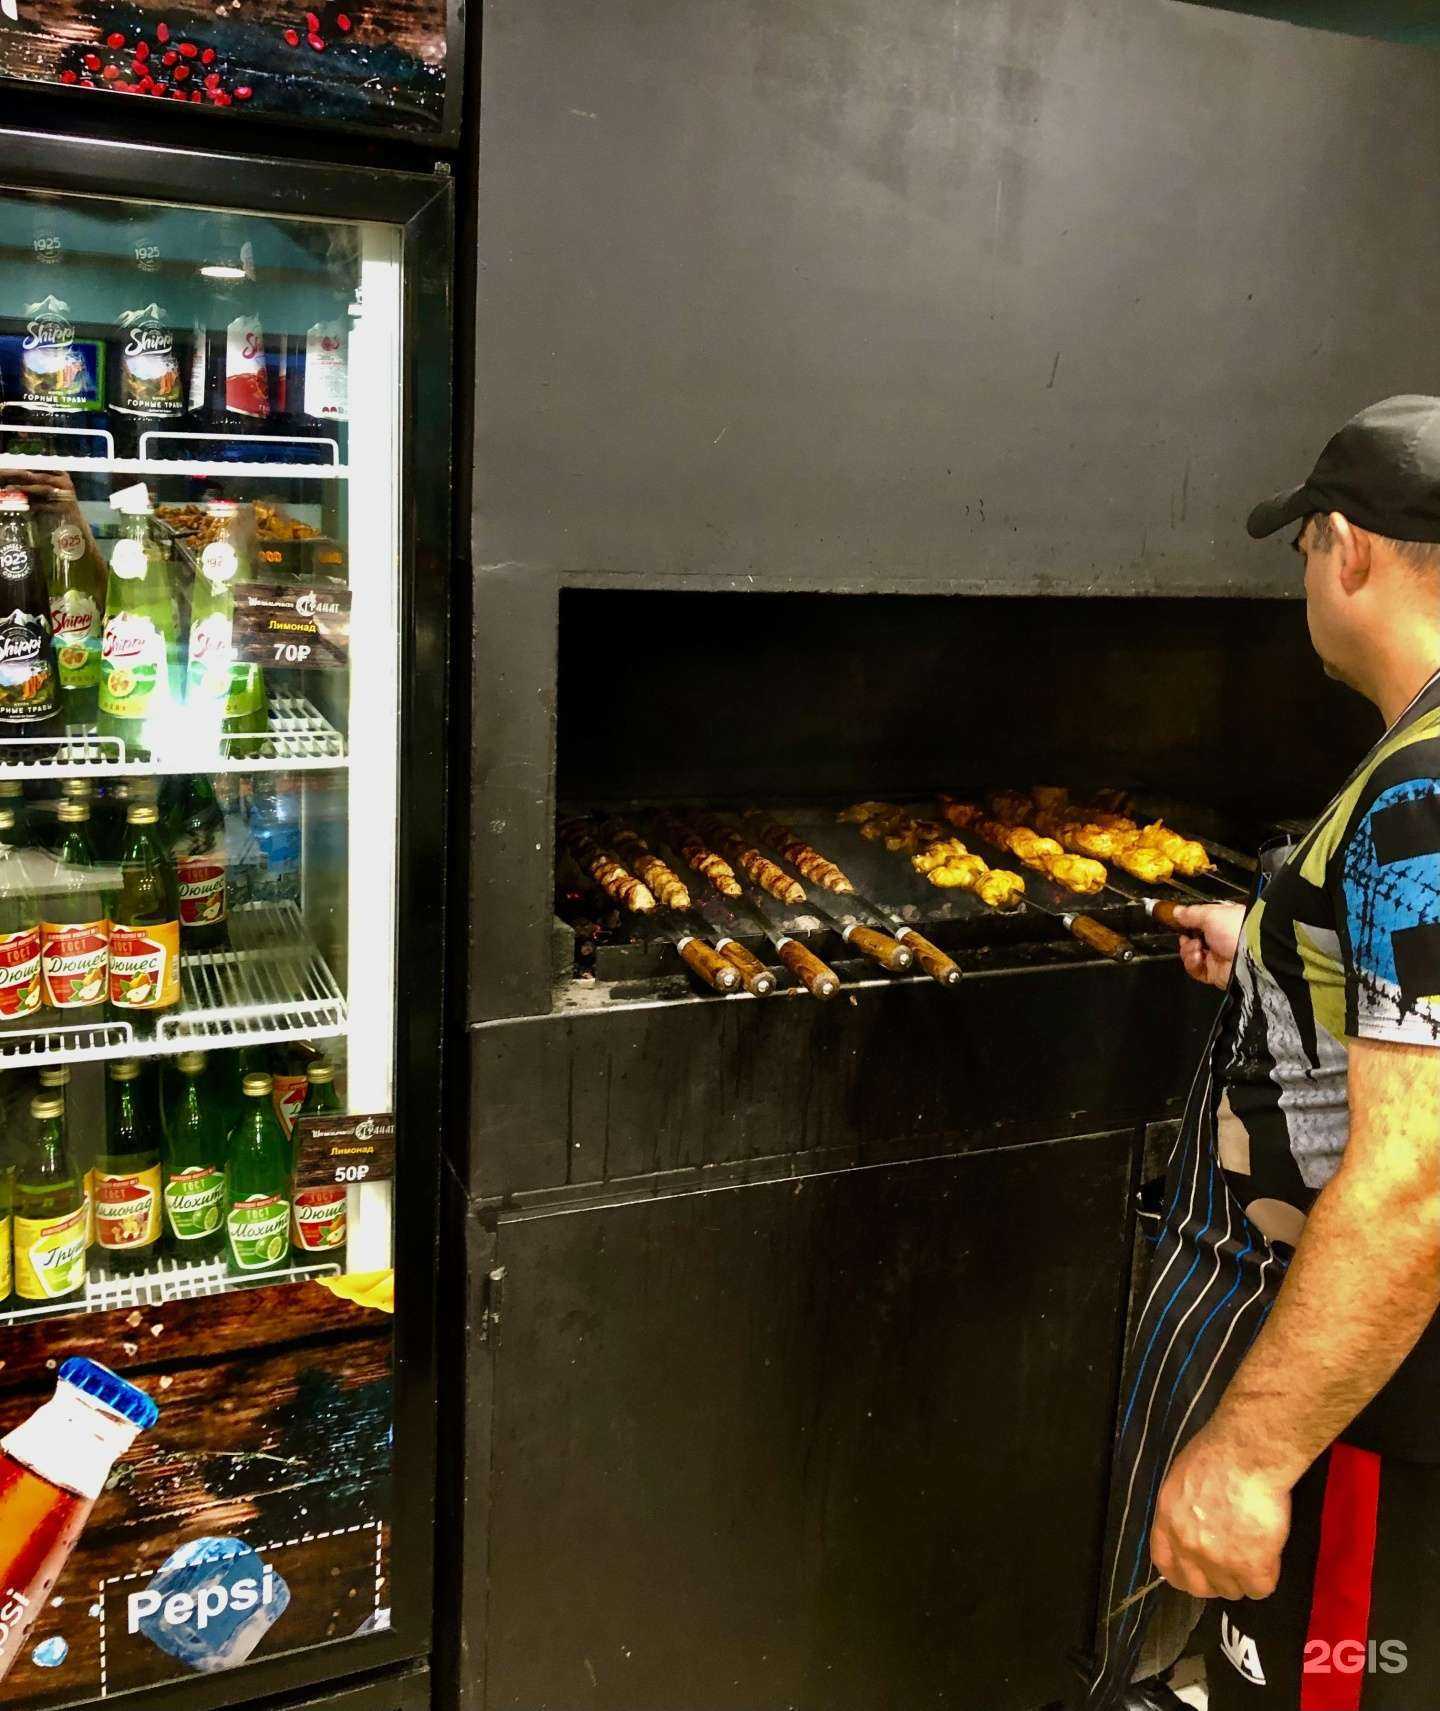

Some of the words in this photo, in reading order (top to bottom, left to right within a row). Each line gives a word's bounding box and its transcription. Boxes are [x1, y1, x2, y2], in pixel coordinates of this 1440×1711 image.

[33, 236, 61, 251] 1925
[134, 246, 160, 260] 1925
[268, 620, 317, 633] Лимонад
[49, 951, 107, 973] Дюшес
[0, 959, 40, 985] Дюше
[330, 1145, 375, 1156] Лимонад
[301, 1201, 347, 1220] Дюше
[127, 1563, 273, 1635] Pepsi
